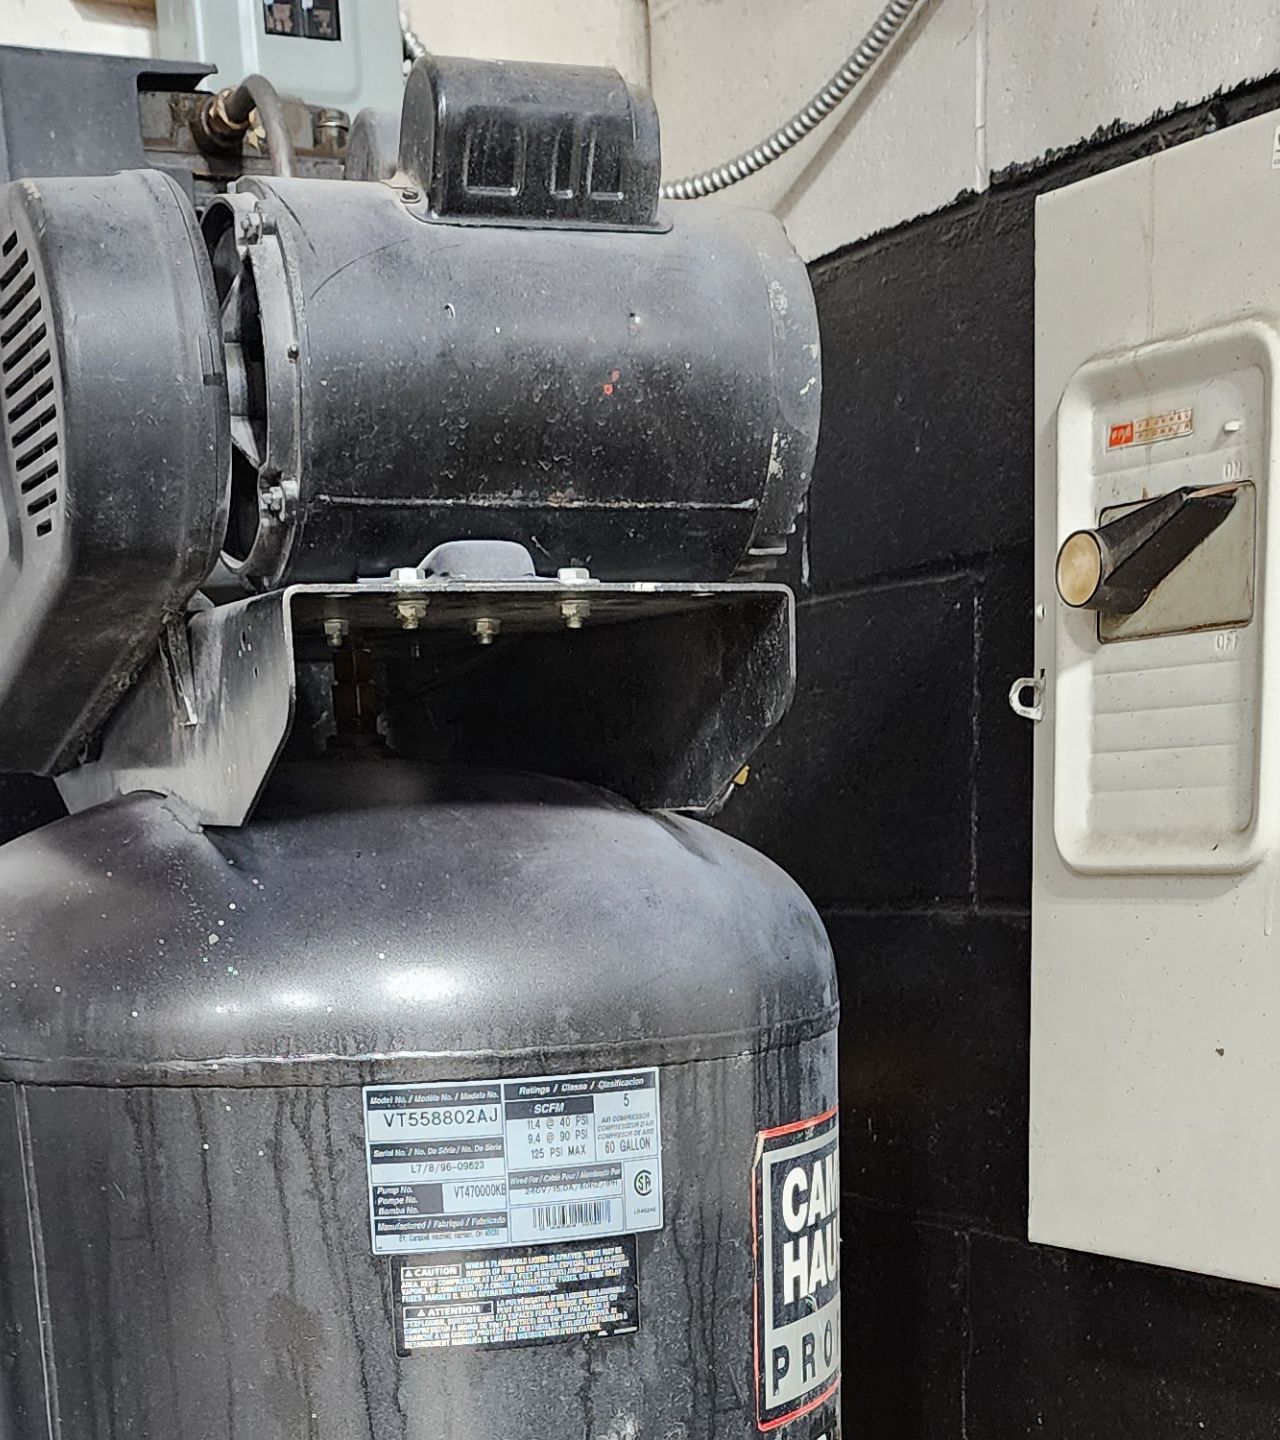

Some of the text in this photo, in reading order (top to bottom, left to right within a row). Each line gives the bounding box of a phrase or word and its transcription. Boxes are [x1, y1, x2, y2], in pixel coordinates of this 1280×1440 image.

[1223, 459, 1242, 479] ON
[1214, 632, 1240, 654] OFF
[533, 1102, 565, 1114] SCFM
[623, 1094, 630, 1107] 5
[383, 1107, 498, 1128] VT558802AJ
[546, 1118, 555, 1130] @
[559, 1117, 570, 1128] 40
[575, 1115, 589, 1126] PSI
[528, 1129, 588, 1144] 9.4 @ 90 PSI
[531, 1145, 586, 1160] 125 PSI MAX
[605, 1137, 651, 1154] 60 GALLON
[377, 1187, 400, 1196] Pump
[400, 1186, 414, 1194] No.
[405, 1196, 418, 1204] No.
[406, 1206, 419, 1215] No.
[414, 1267, 457, 1277] CAUTION
[427, 1306, 481, 1317] ATTENTION
[772, 1309, 839, 1397] PRO
